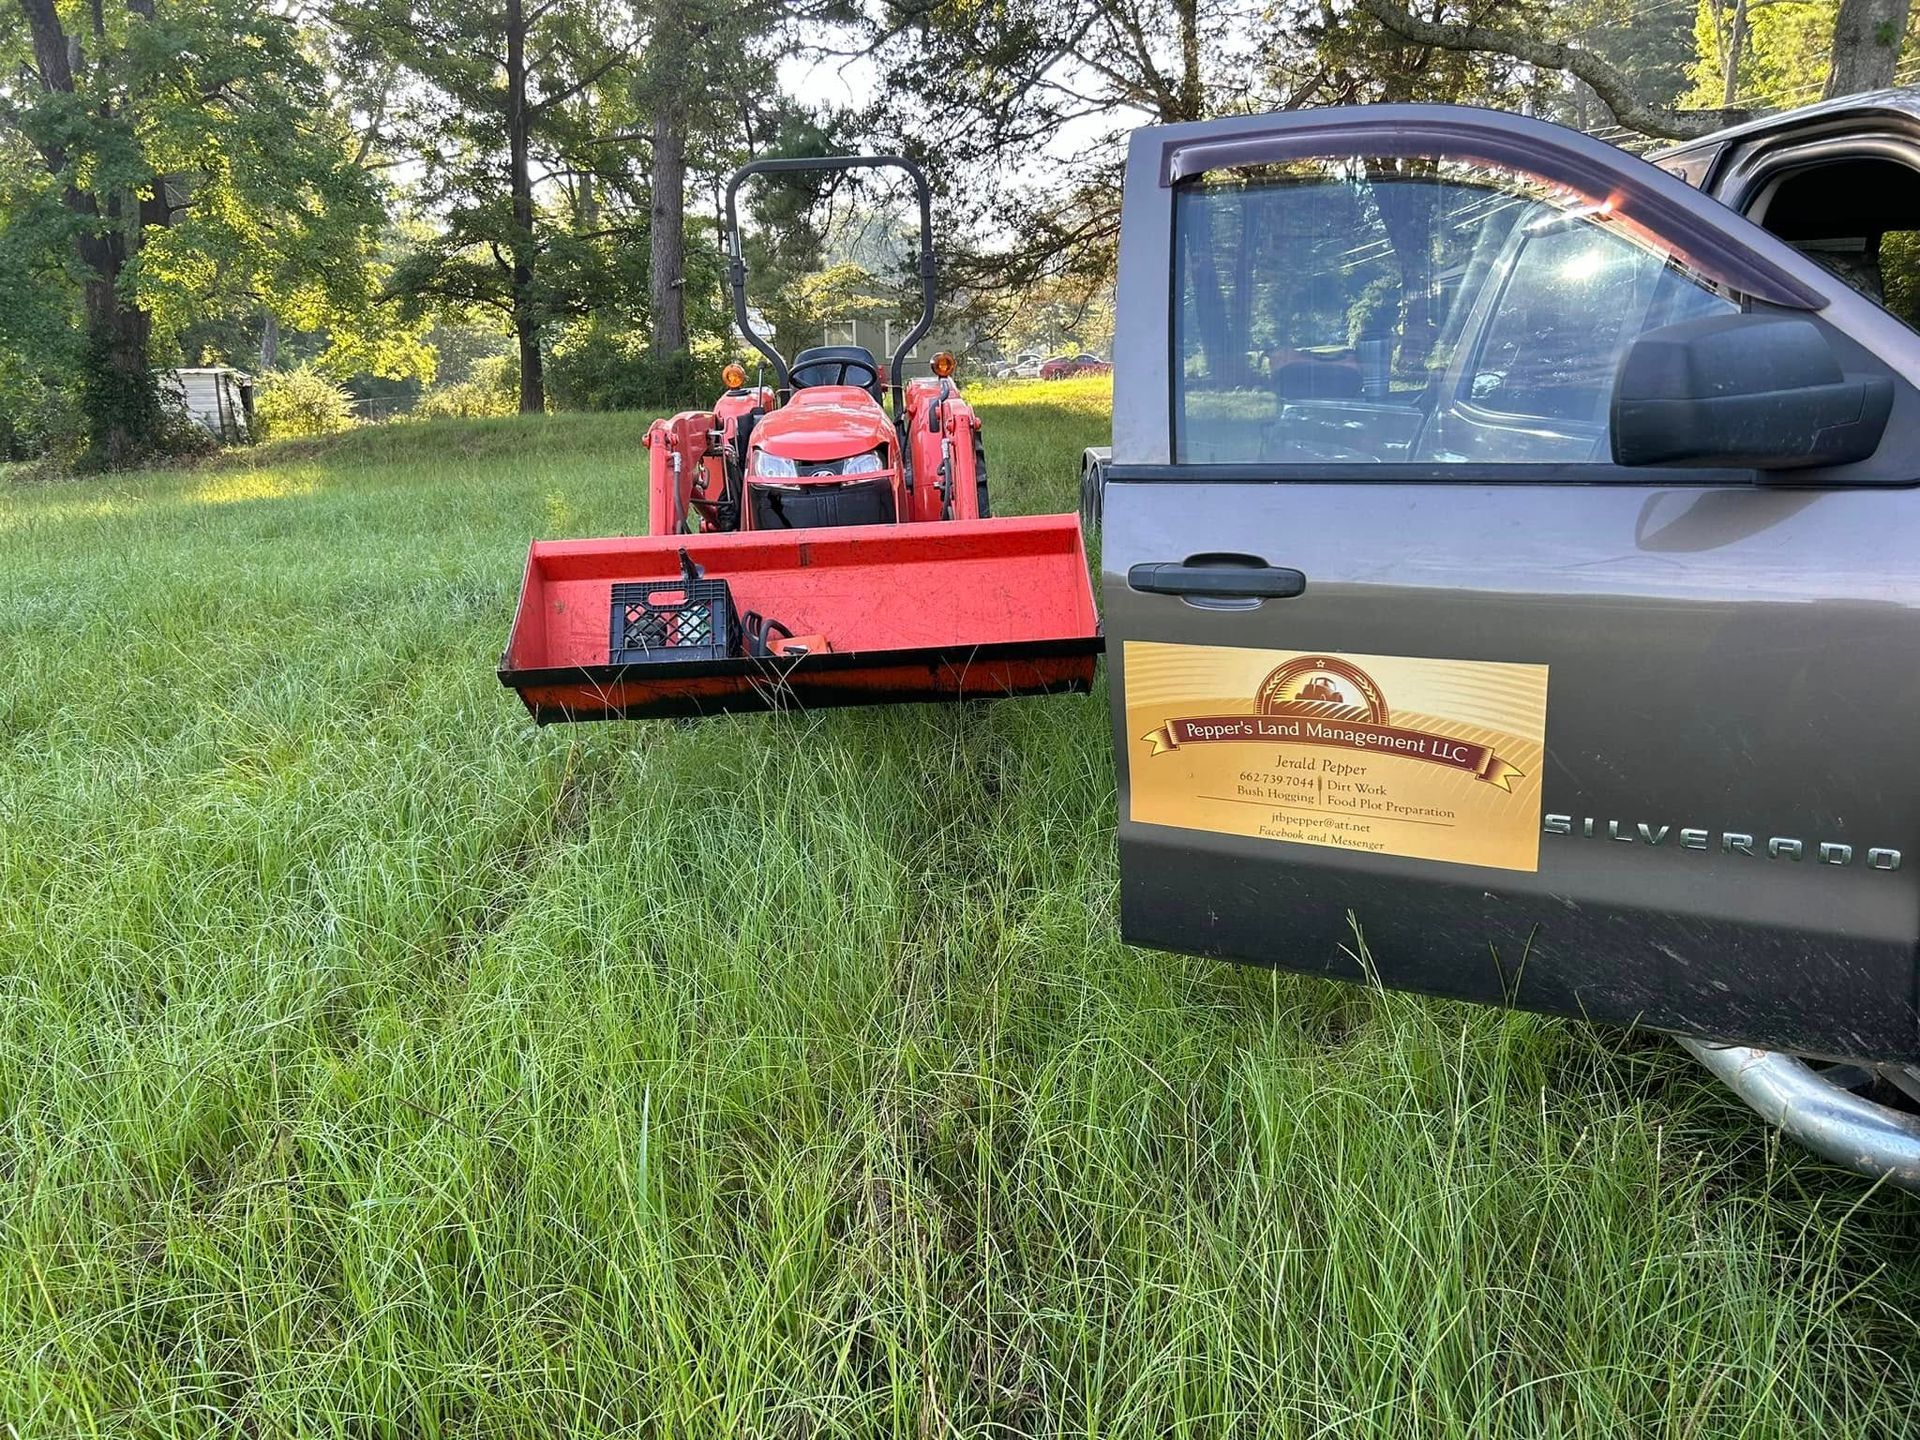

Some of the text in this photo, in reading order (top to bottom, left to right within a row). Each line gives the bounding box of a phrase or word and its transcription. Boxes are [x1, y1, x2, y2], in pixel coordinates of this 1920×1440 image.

[1186, 720, 1469, 763] Pepper's Land Management LLC
[1275, 755, 1368, 777] Jerald Pepper
[1237, 785, 1315, 806] Bush Hogging
[1327, 780, 1388, 797] Dirt Work
[1327, 795, 1456, 820] Food Plot Preparation
[1258, 825, 1385, 852] Facebook and Messenger
[1543, 813, 1902, 872] SILVERADO
